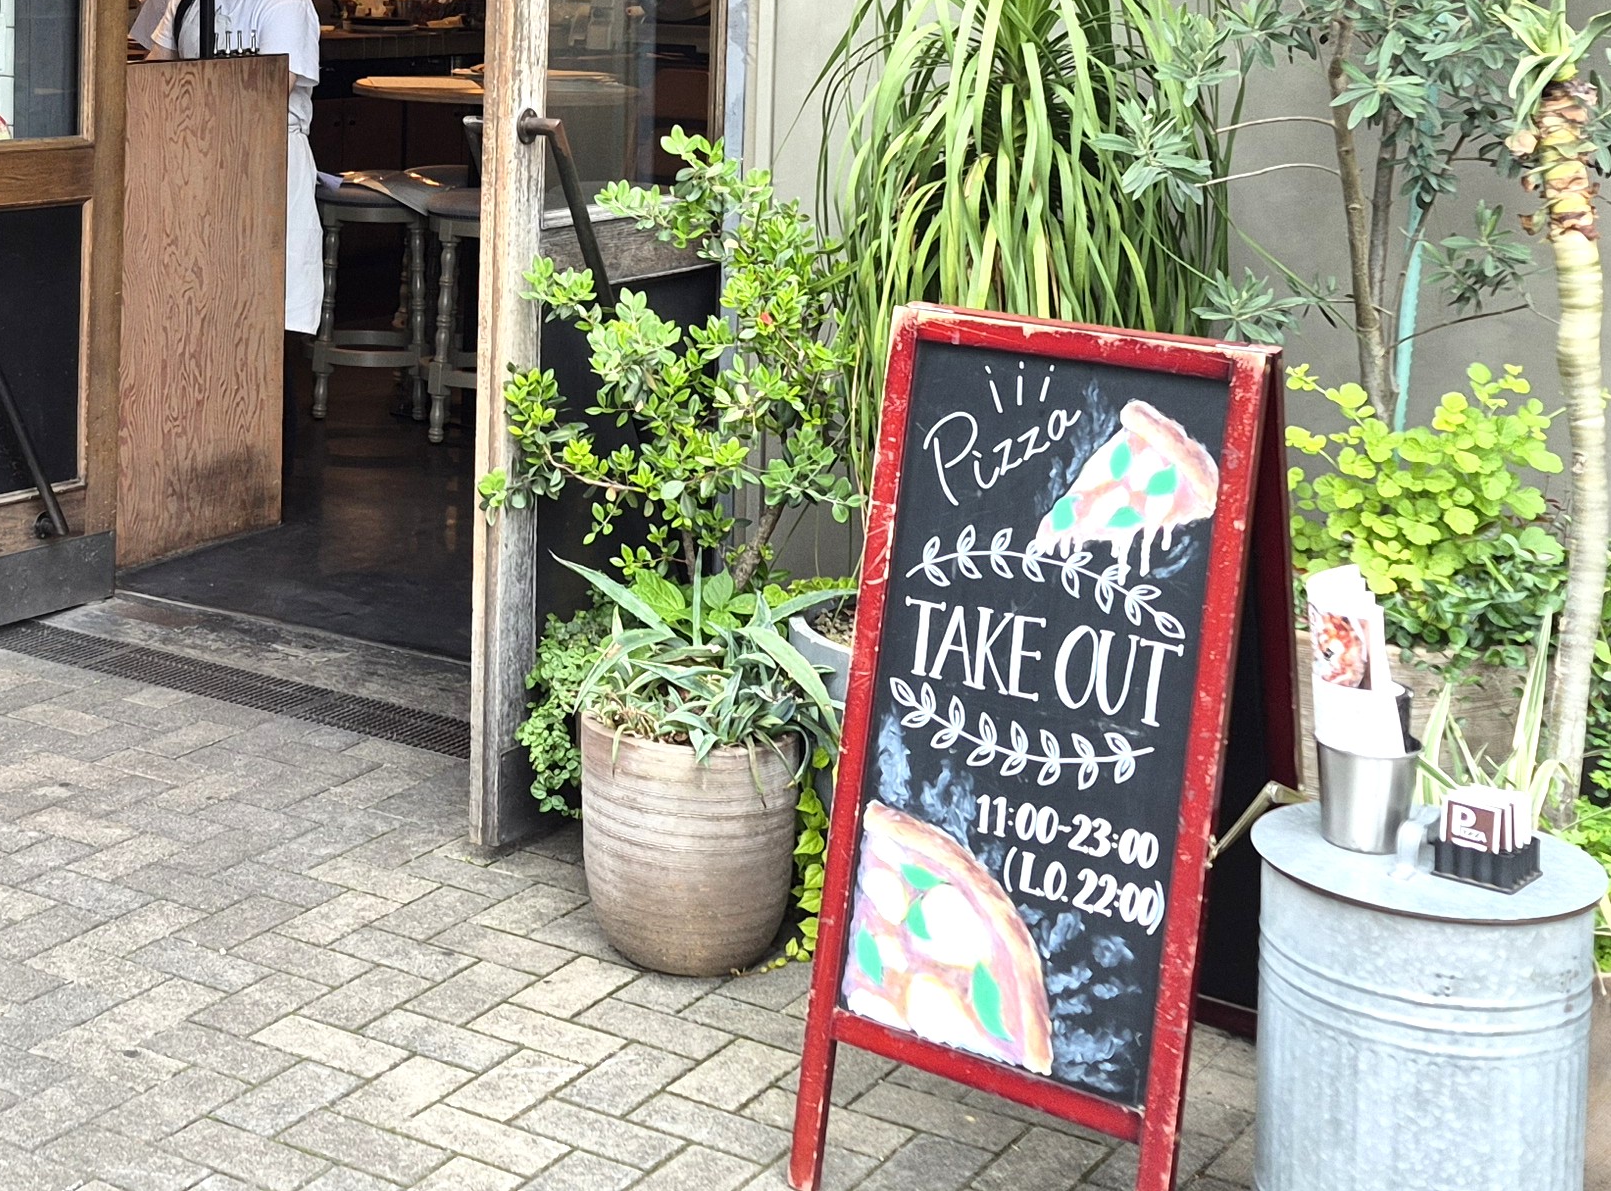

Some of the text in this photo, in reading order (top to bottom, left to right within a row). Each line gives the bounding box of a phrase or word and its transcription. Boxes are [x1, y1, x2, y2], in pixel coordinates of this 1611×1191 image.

[922, 408, 1082, 507] Pizza
[904, 595, 1185, 728] TAKE OUT
[974, 793, 1160, 870] 11:00-23:00
[1071, 867, 1166, 936] 22:00)
